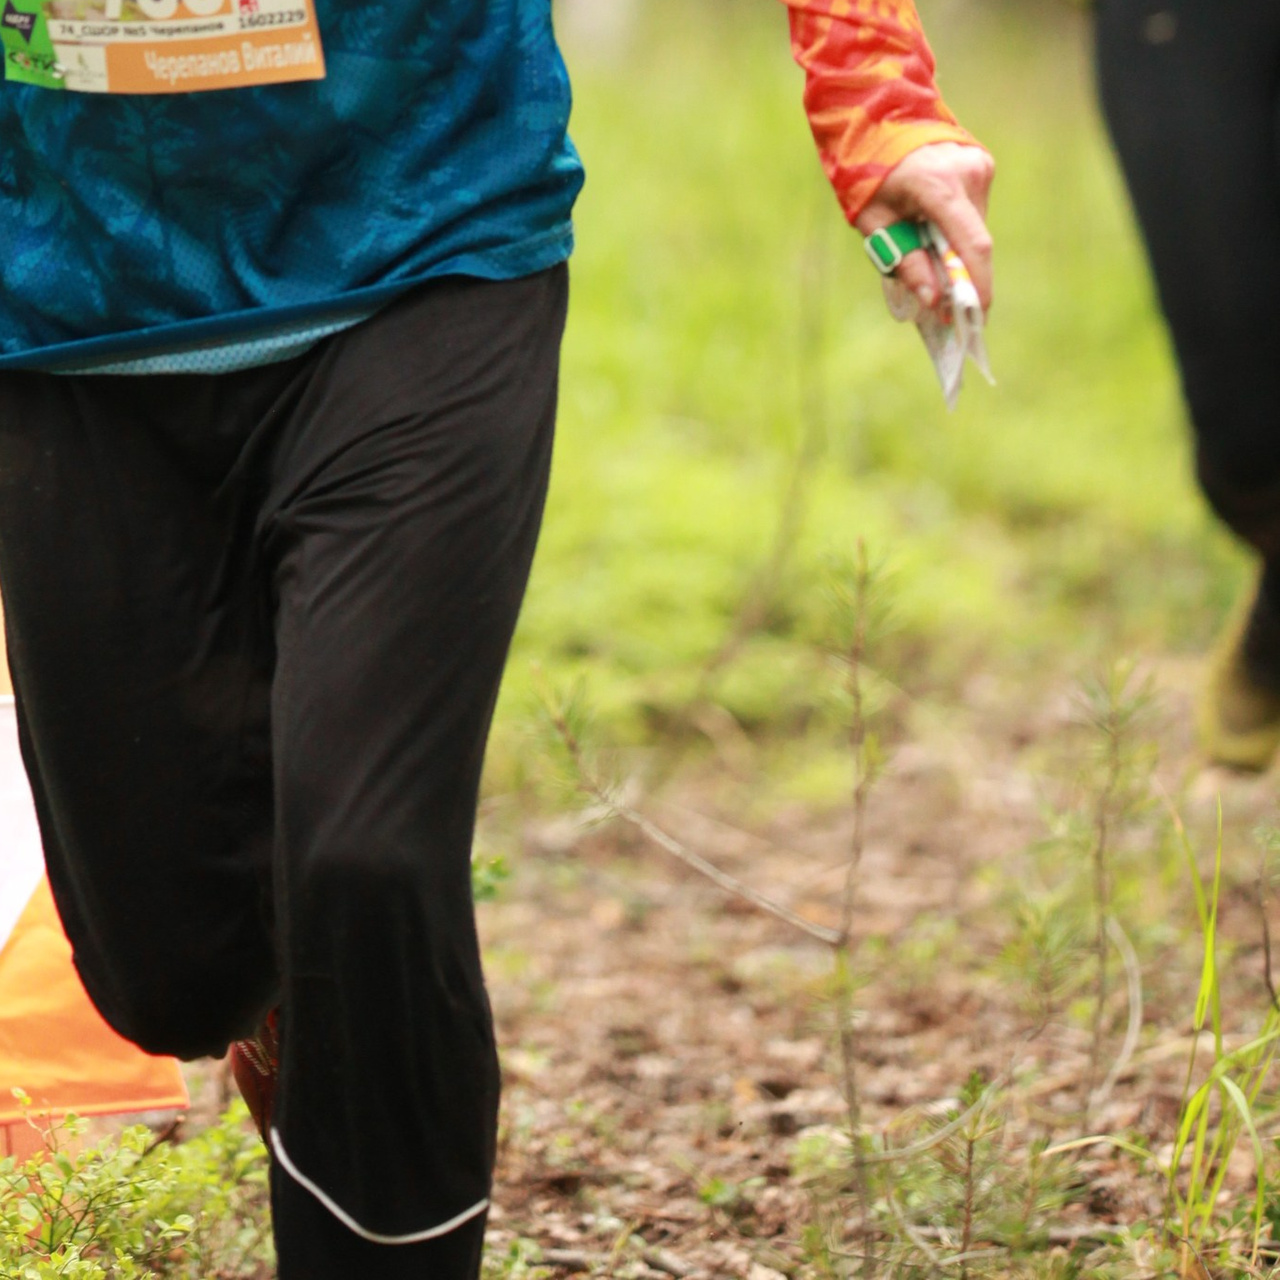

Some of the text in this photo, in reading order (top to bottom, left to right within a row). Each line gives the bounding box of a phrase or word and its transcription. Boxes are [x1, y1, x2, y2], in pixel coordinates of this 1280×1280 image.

[238, 10, 306, 30] 1602229
[143, 48, 241, 86] Черепанов
[241, 32, 316, 73] Виталий
